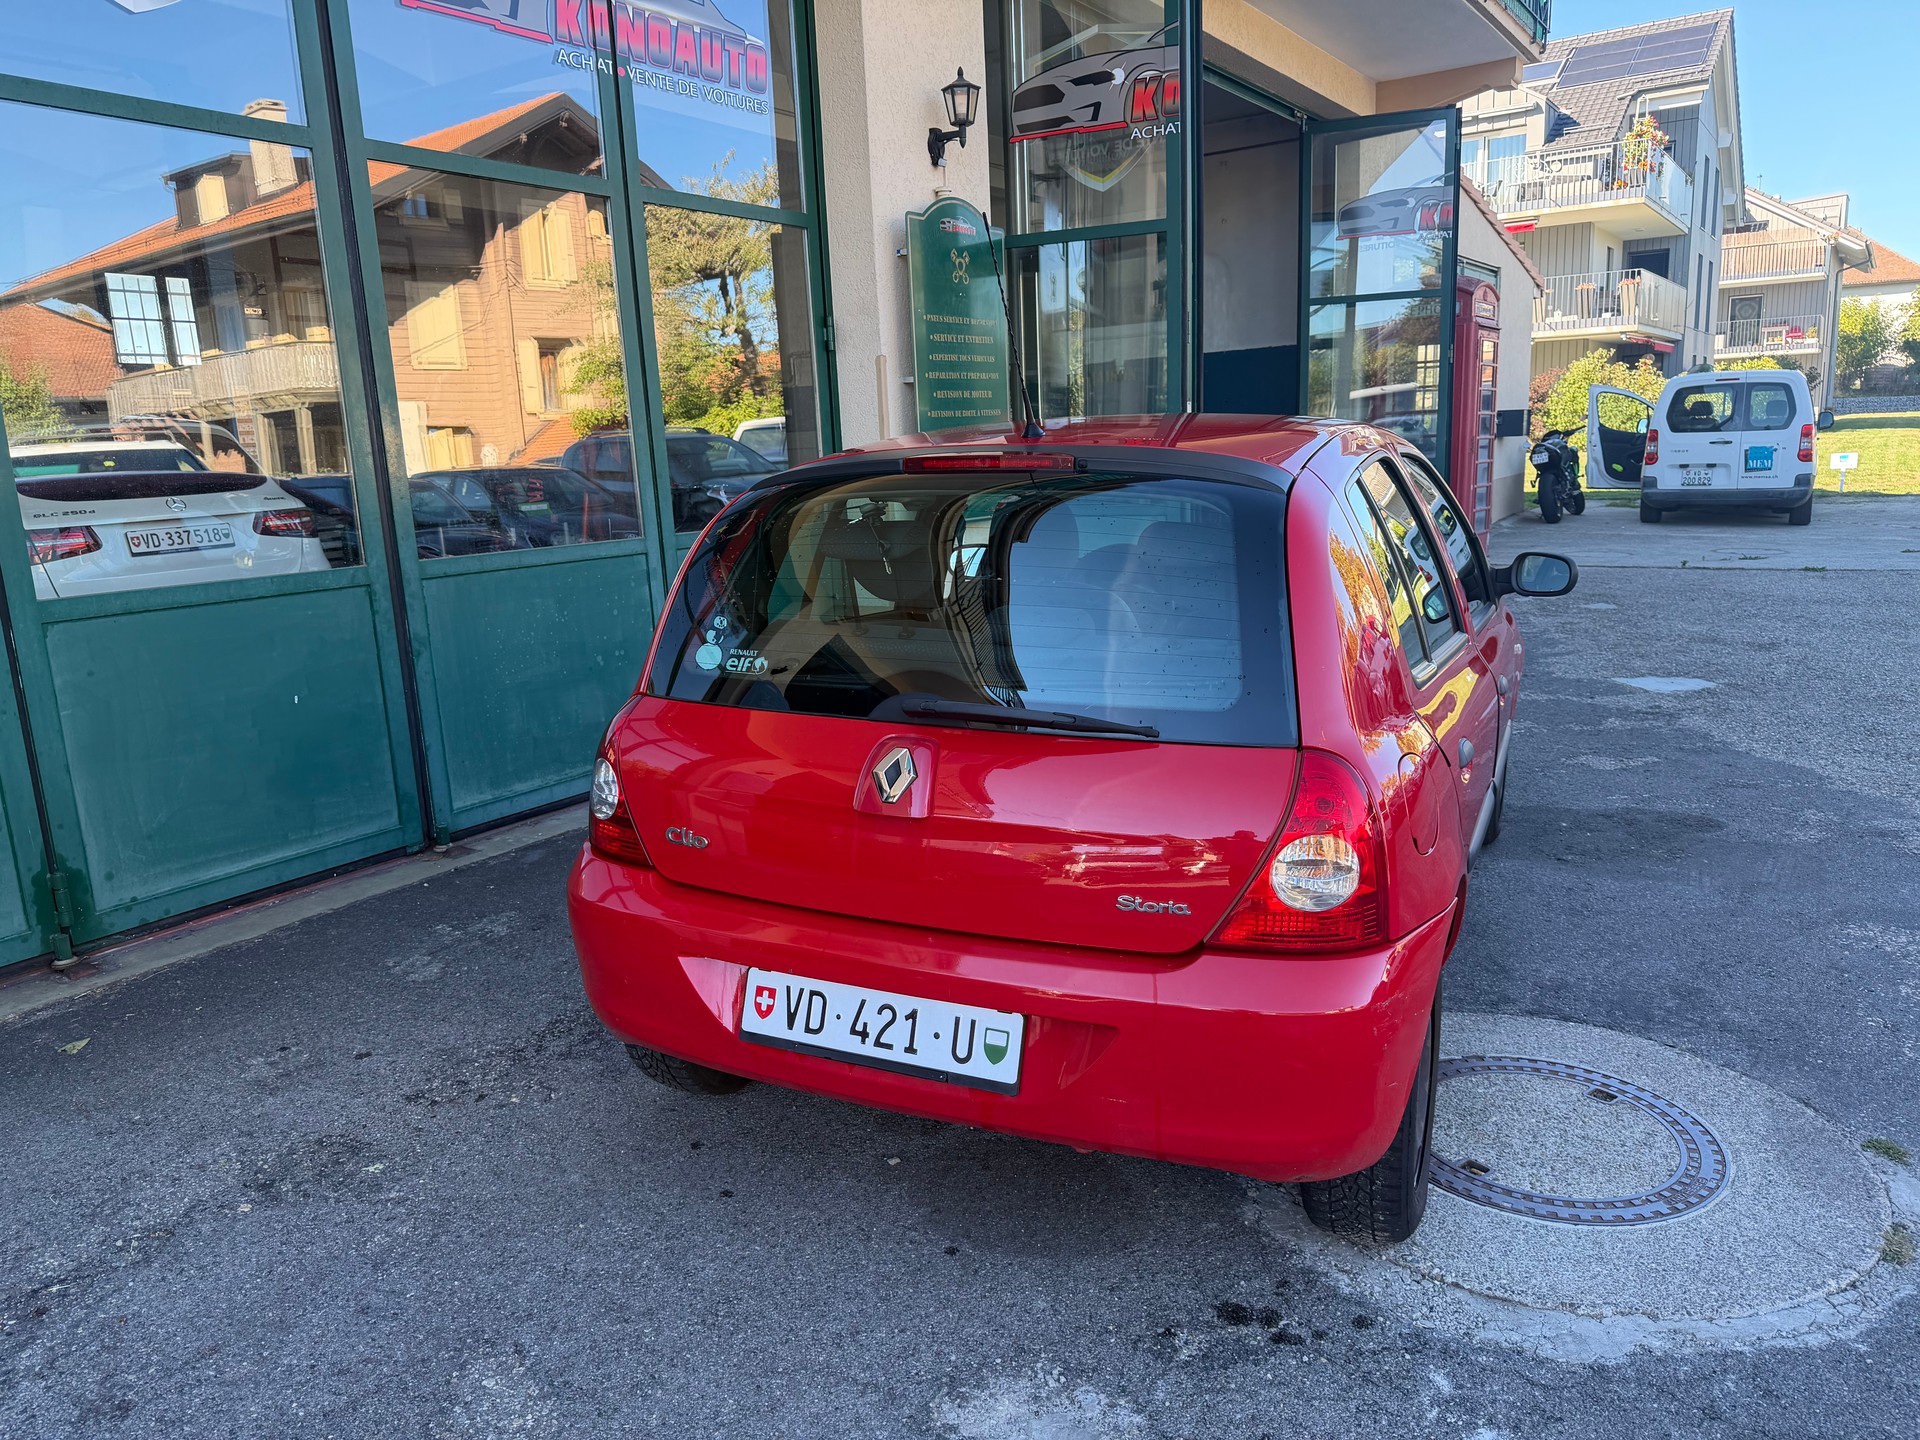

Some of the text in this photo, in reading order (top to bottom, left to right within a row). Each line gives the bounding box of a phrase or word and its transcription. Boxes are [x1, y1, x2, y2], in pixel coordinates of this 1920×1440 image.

[555, 0, 768, 95] KONOAUTO
[678, 79, 699, 98] DE
[703, 85, 769, 115] VOITURES
[943, 316, 963, 325] SERVICE
[933, 333, 994, 344] SERVICE ET ENTRETIEN
[932, 354, 959, 362] EXPERTISE
[959, 354, 971, 362] TOUS
[937, 390, 993, 399] REVISION DE MOTEUR
[931, 410, 955, 418] REVISION
[981, 408, 1001, 417] VITESSES
[1747, 459, 1773, 468] MEM
[32, 511, 59, 519] GLC
[729, 648, 759, 657] RENAULT
[725, 656, 754, 672] elf
[665, 826, 710, 849] Clio
[1115, 894, 1192, 916] Storia
